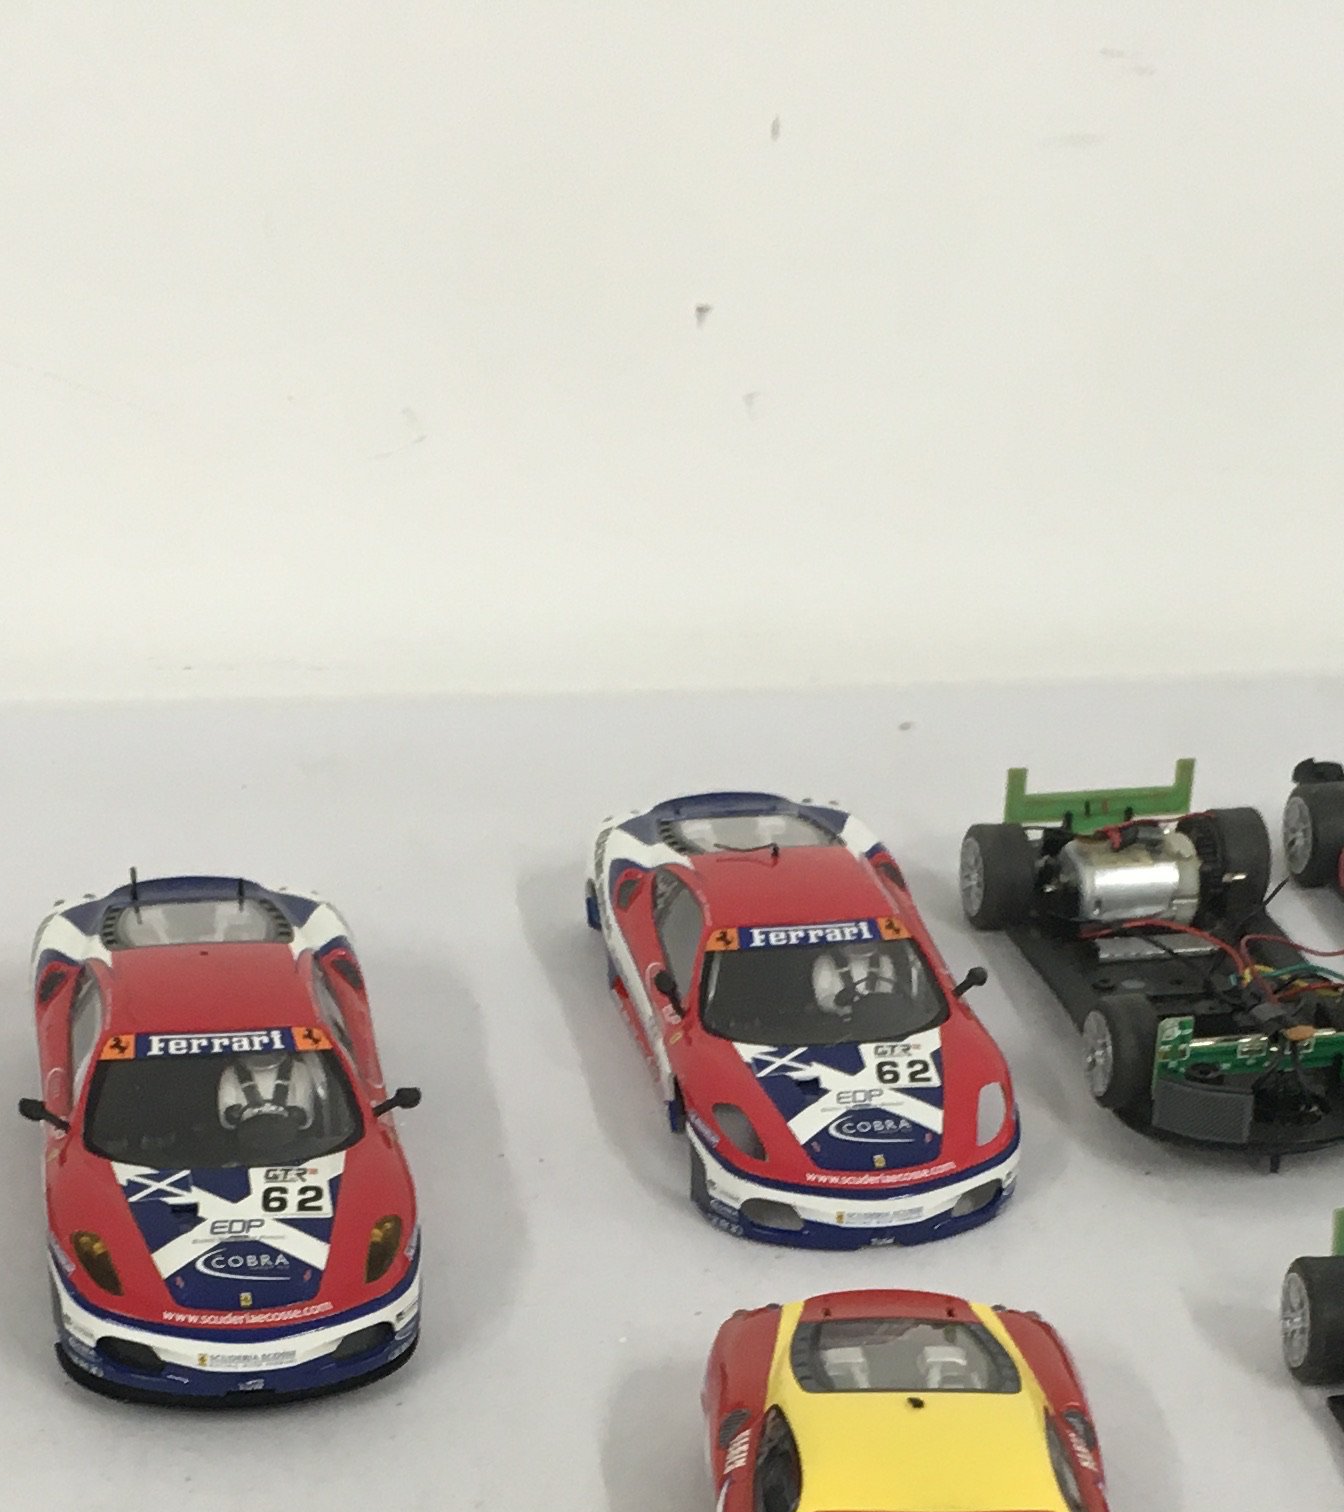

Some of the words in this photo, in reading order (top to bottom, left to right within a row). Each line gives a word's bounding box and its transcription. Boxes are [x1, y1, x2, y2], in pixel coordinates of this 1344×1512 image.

[749, 921, 874, 948] Ferrari
[146, 1030, 286, 1056] Ferrari
[876, 1059, 932, 1084] 62
[841, 1119, 912, 1134] COBRA
[262, 1186, 324, 1213] 62
[211, 1253, 290, 1269] COBRA
